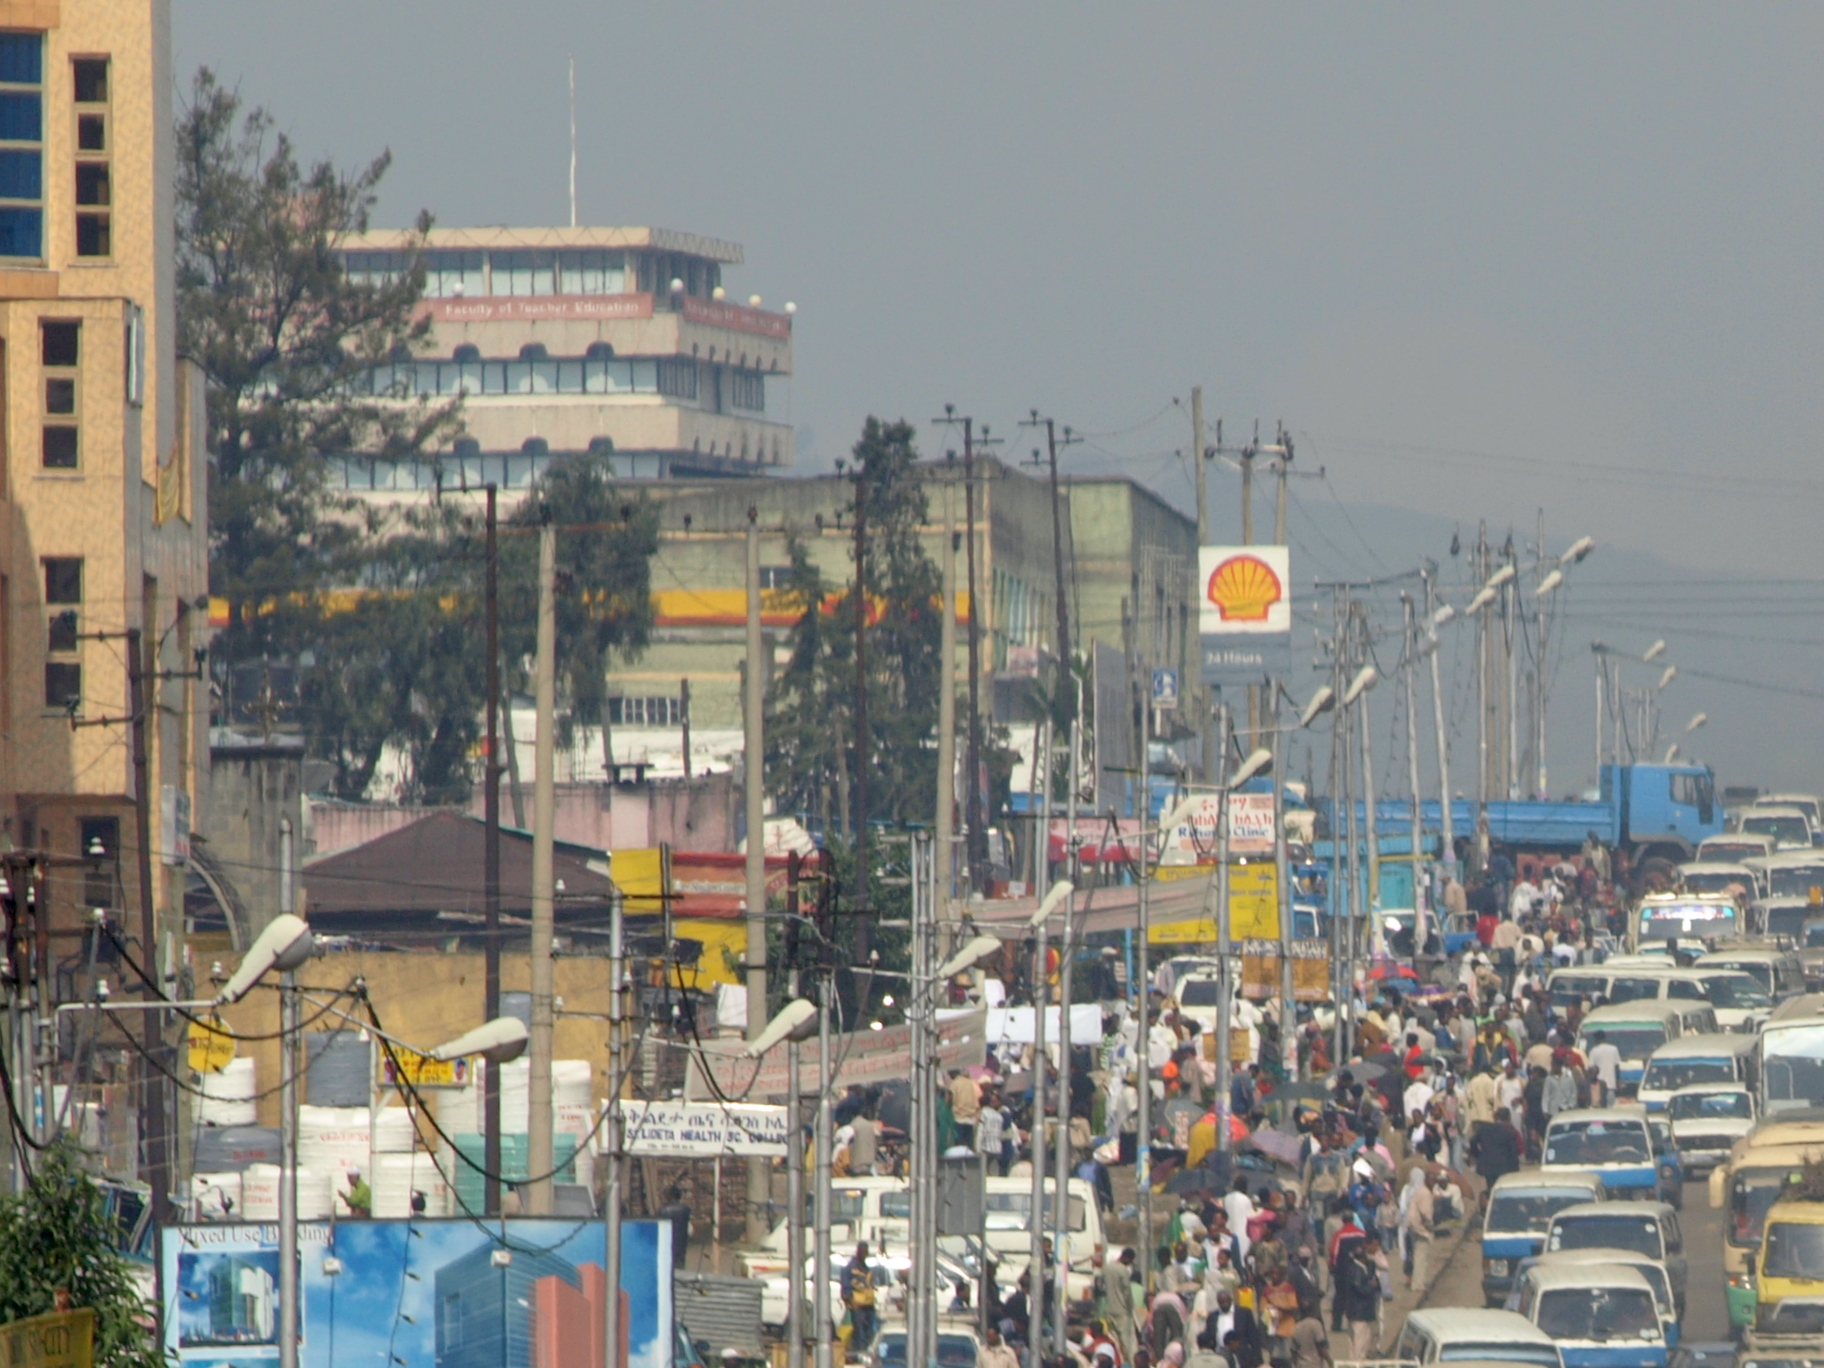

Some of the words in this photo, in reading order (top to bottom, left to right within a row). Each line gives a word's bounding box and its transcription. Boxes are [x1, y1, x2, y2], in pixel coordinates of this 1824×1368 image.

[445, 304, 493, 316] Faculty
[499, 302, 512, 312] of
[518, 302, 567, 313] Teacher
[575, 301, 639, 312] Education
[1223, 650, 1262, 664] Hours
[1233, 825, 1269, 838] Clinic
[680, 1129, 721, 1143] HEALTH
[178, 1227, 226, 1244] Mixed
[231, 1225, 260, 1243] Use
